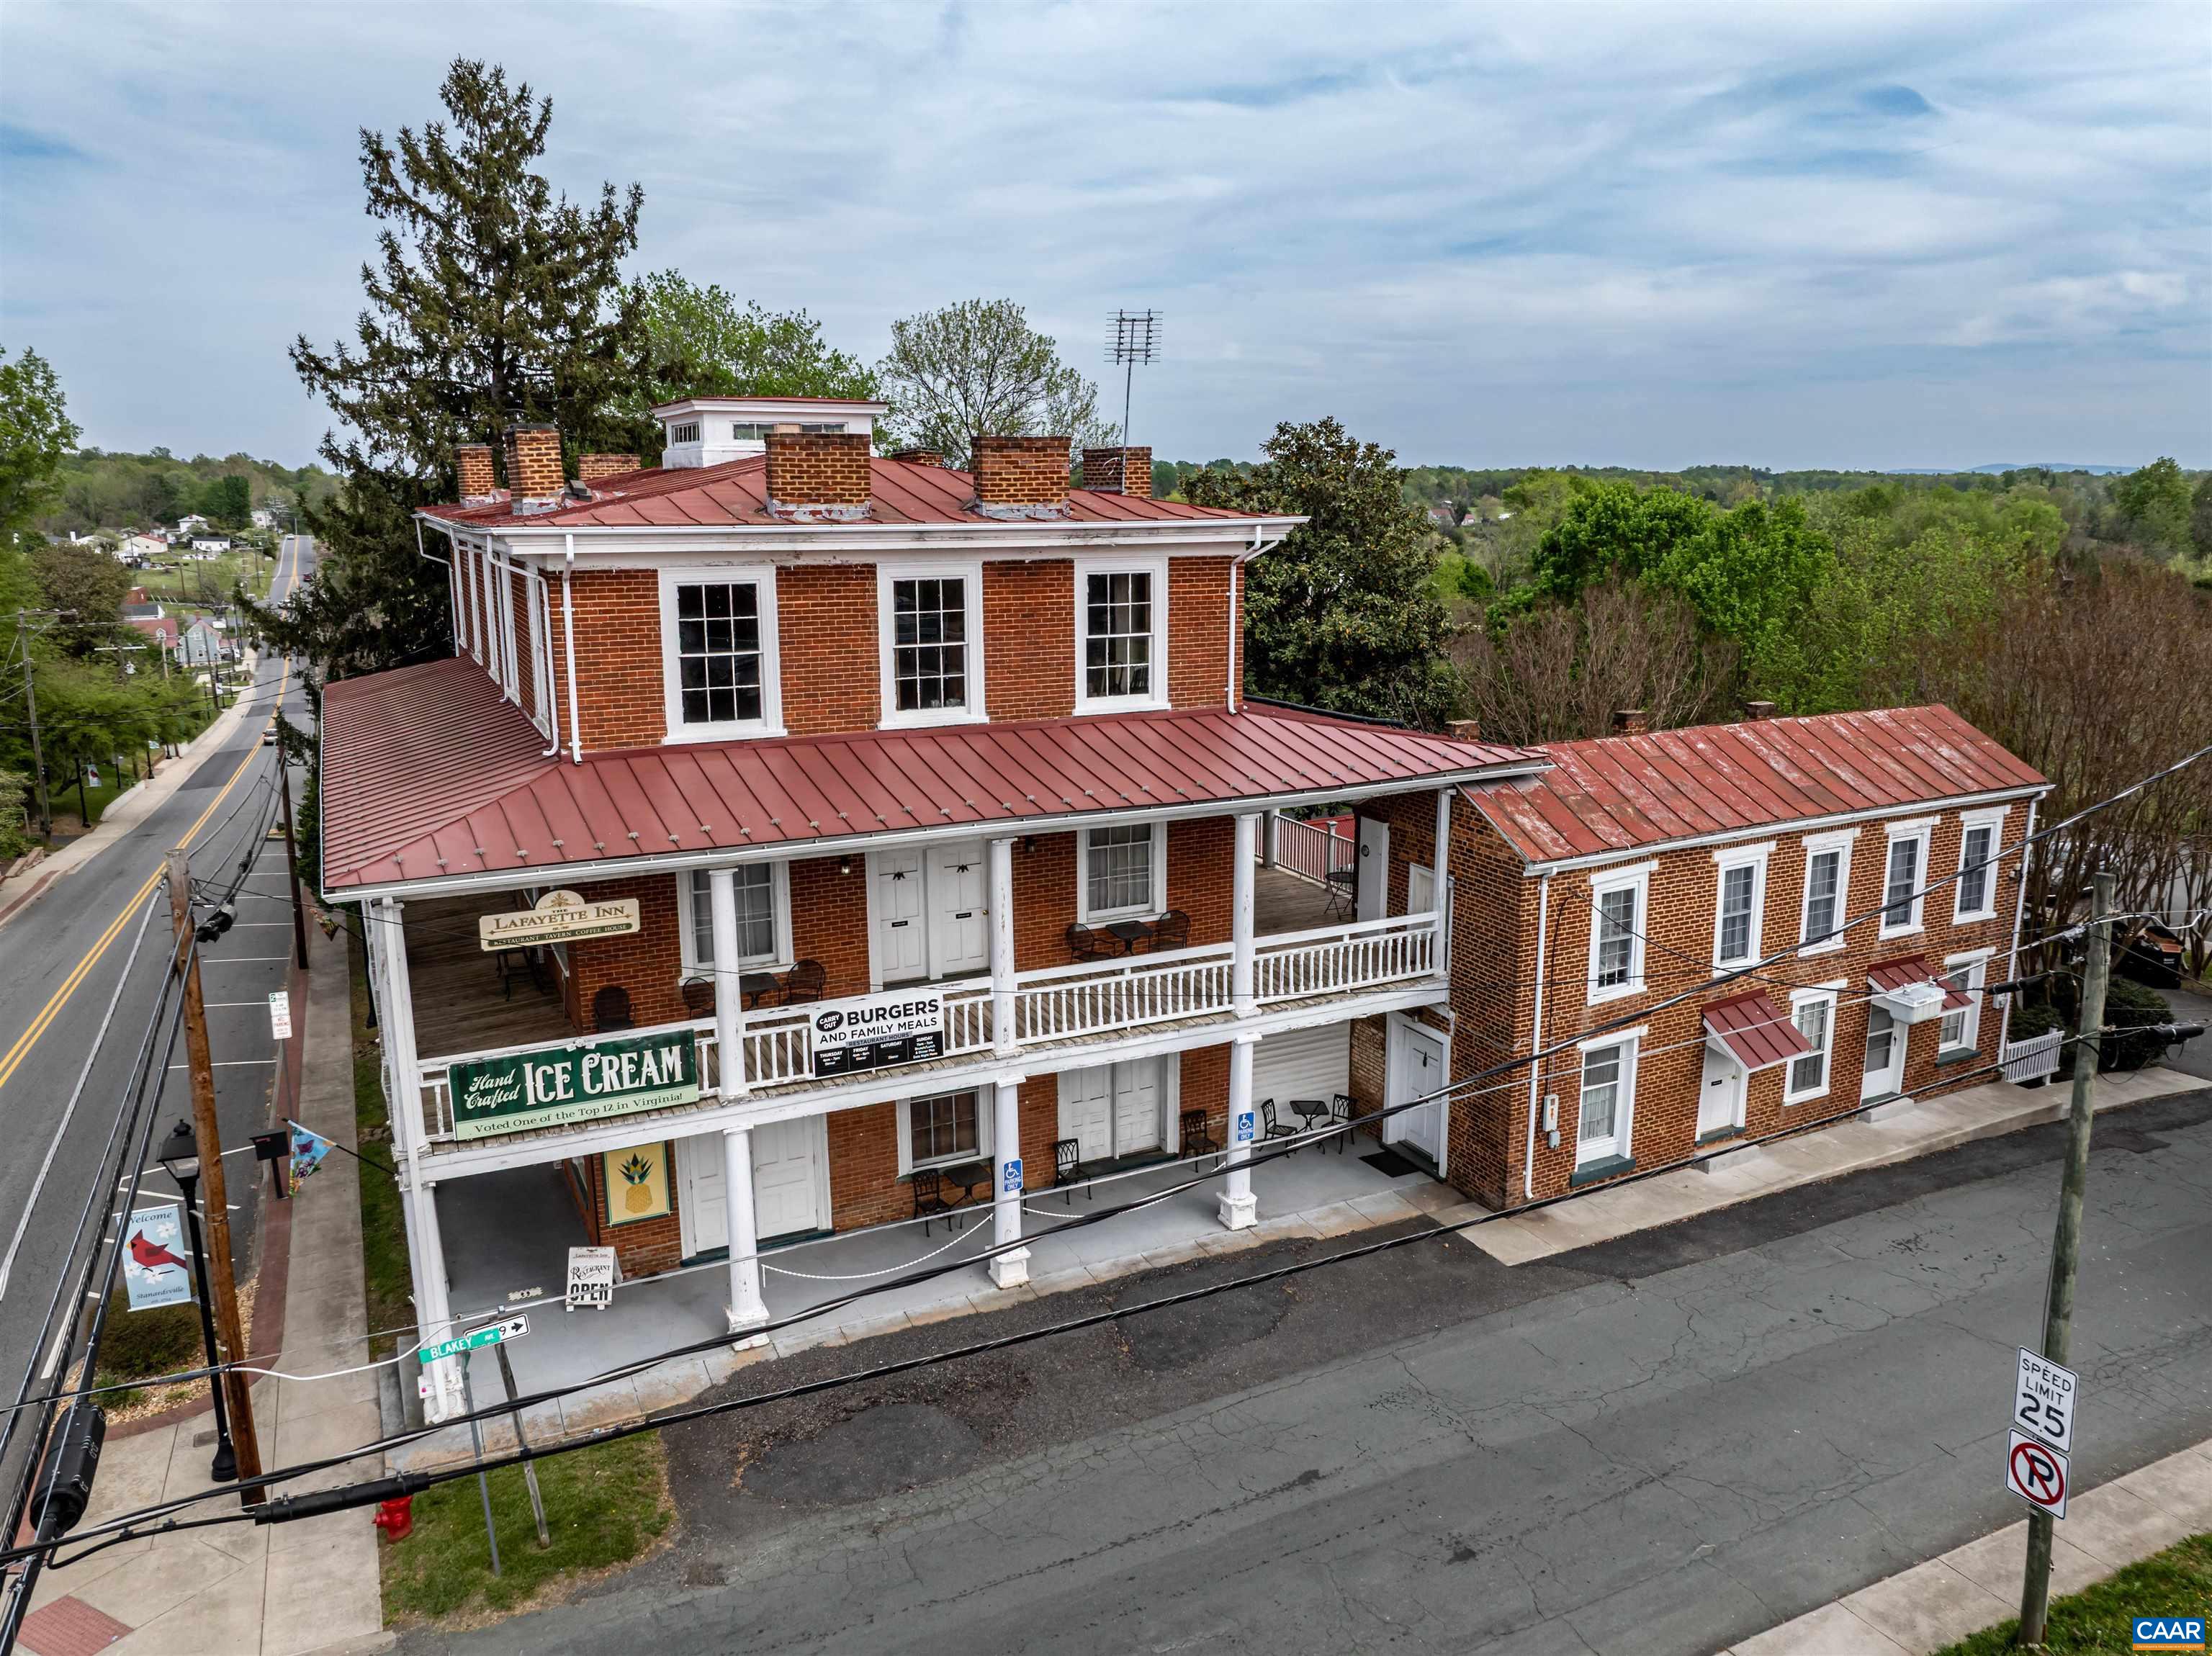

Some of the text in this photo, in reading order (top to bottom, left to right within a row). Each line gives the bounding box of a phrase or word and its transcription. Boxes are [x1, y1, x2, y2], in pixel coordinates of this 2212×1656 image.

[494, 906, 625, 930] LAFAYETTE INN
[819, 1014, 840, 1025] CARRY
[847, 999, 939, 1026] BURGERS
[819, 1017, 938, 1044] AND FAMILY MEALS
[824, 1021, 836, 1030] OUT
[849, 1033, 909, 1046] RESTAURANT HOURS
[469, 1068, 516, 1092] Hand
[523, 1045, 684, 1106] ICE CREAM
[464, 1084, 520, 1110] Crafted
[474, 1092, 683, 1133] Voted One of the Top 12 in Virginia!
[1238, 1127, 1254, 1135] PARKING
[1004, 1176, 1022, 1185] PARKING
[570, 1264, 611, 1281] RESTAURANT
[138, 1286, 184, 1298] Stanardsville
[570, 1283, 609, 1302] OPEN
[430, 1333, 495, 1359] BLAKEY AVE
[2022, 1358, 2072, 1392] SPEED
[2026, 1376, 2064, 1405] LIMIT
[2020, 1392, 2065, 1438] 25
[2028, 1453, 2054, 1488] P
